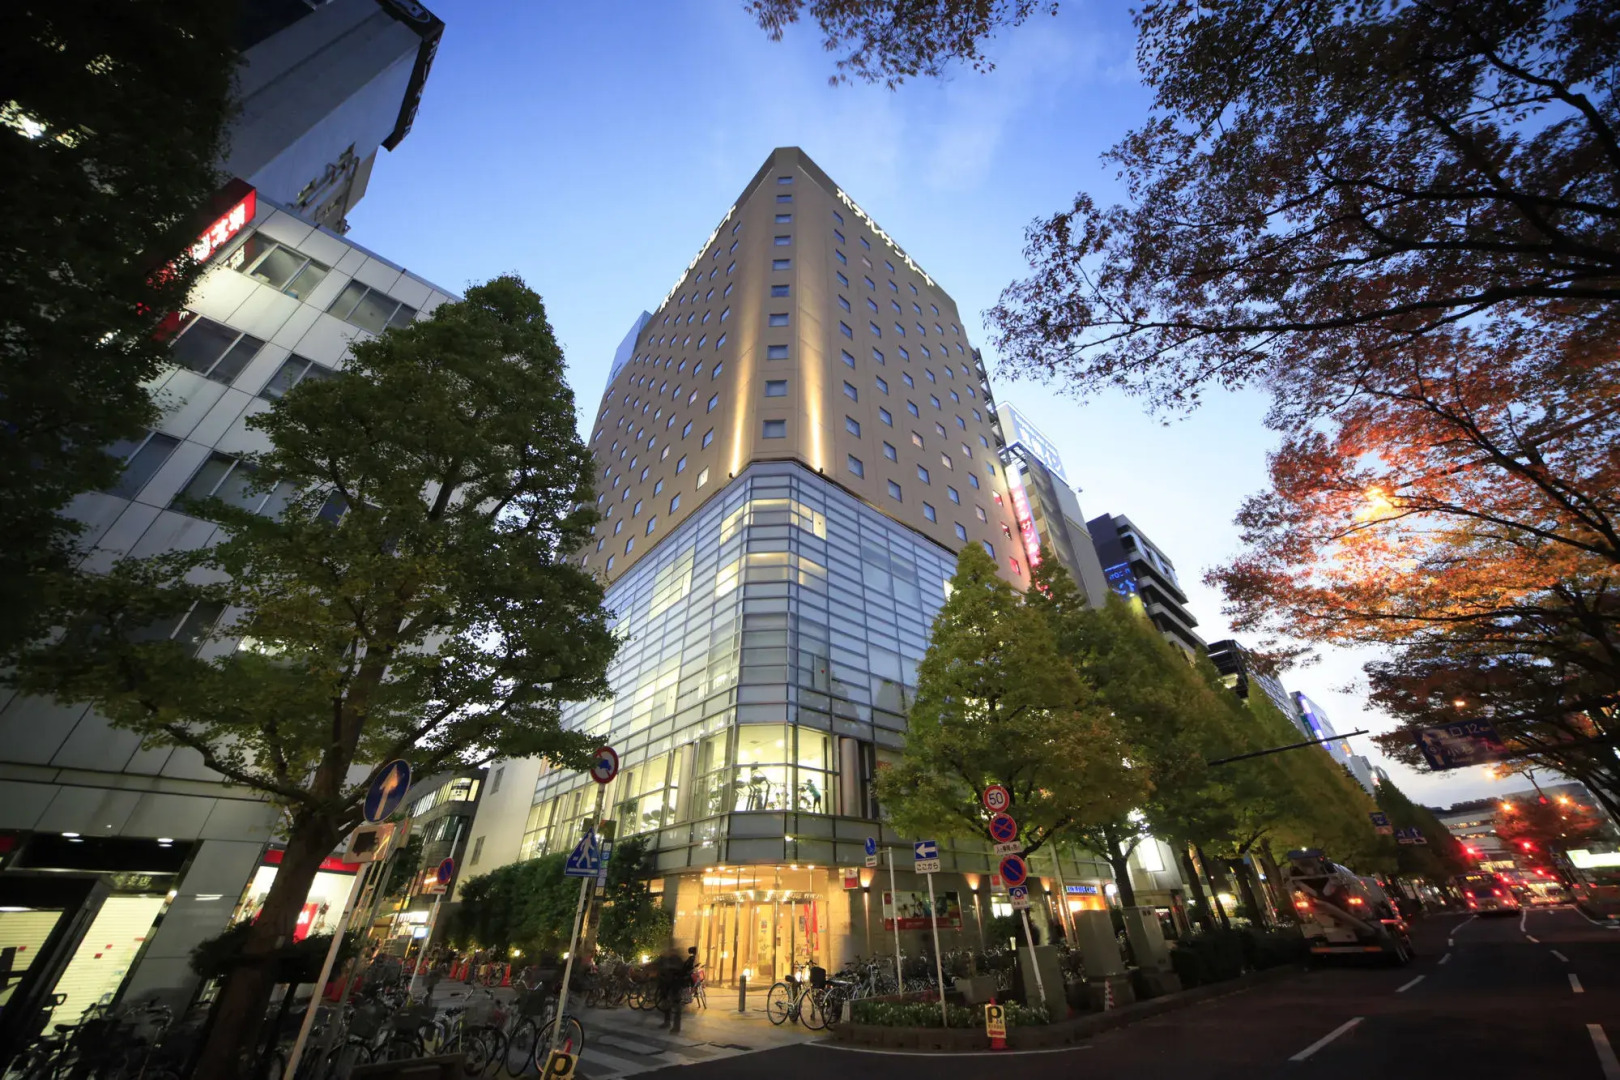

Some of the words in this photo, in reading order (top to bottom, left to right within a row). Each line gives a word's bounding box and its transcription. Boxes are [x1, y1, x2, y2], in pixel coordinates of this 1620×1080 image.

[837, 188, 934, 286] ホテルサンルート
[988, 792, 1005, 805] 50
[916, 862, 939, 871] ここから
[987, 1006, 1002, 1023] P
[543, 1054, 573, 1080] P
